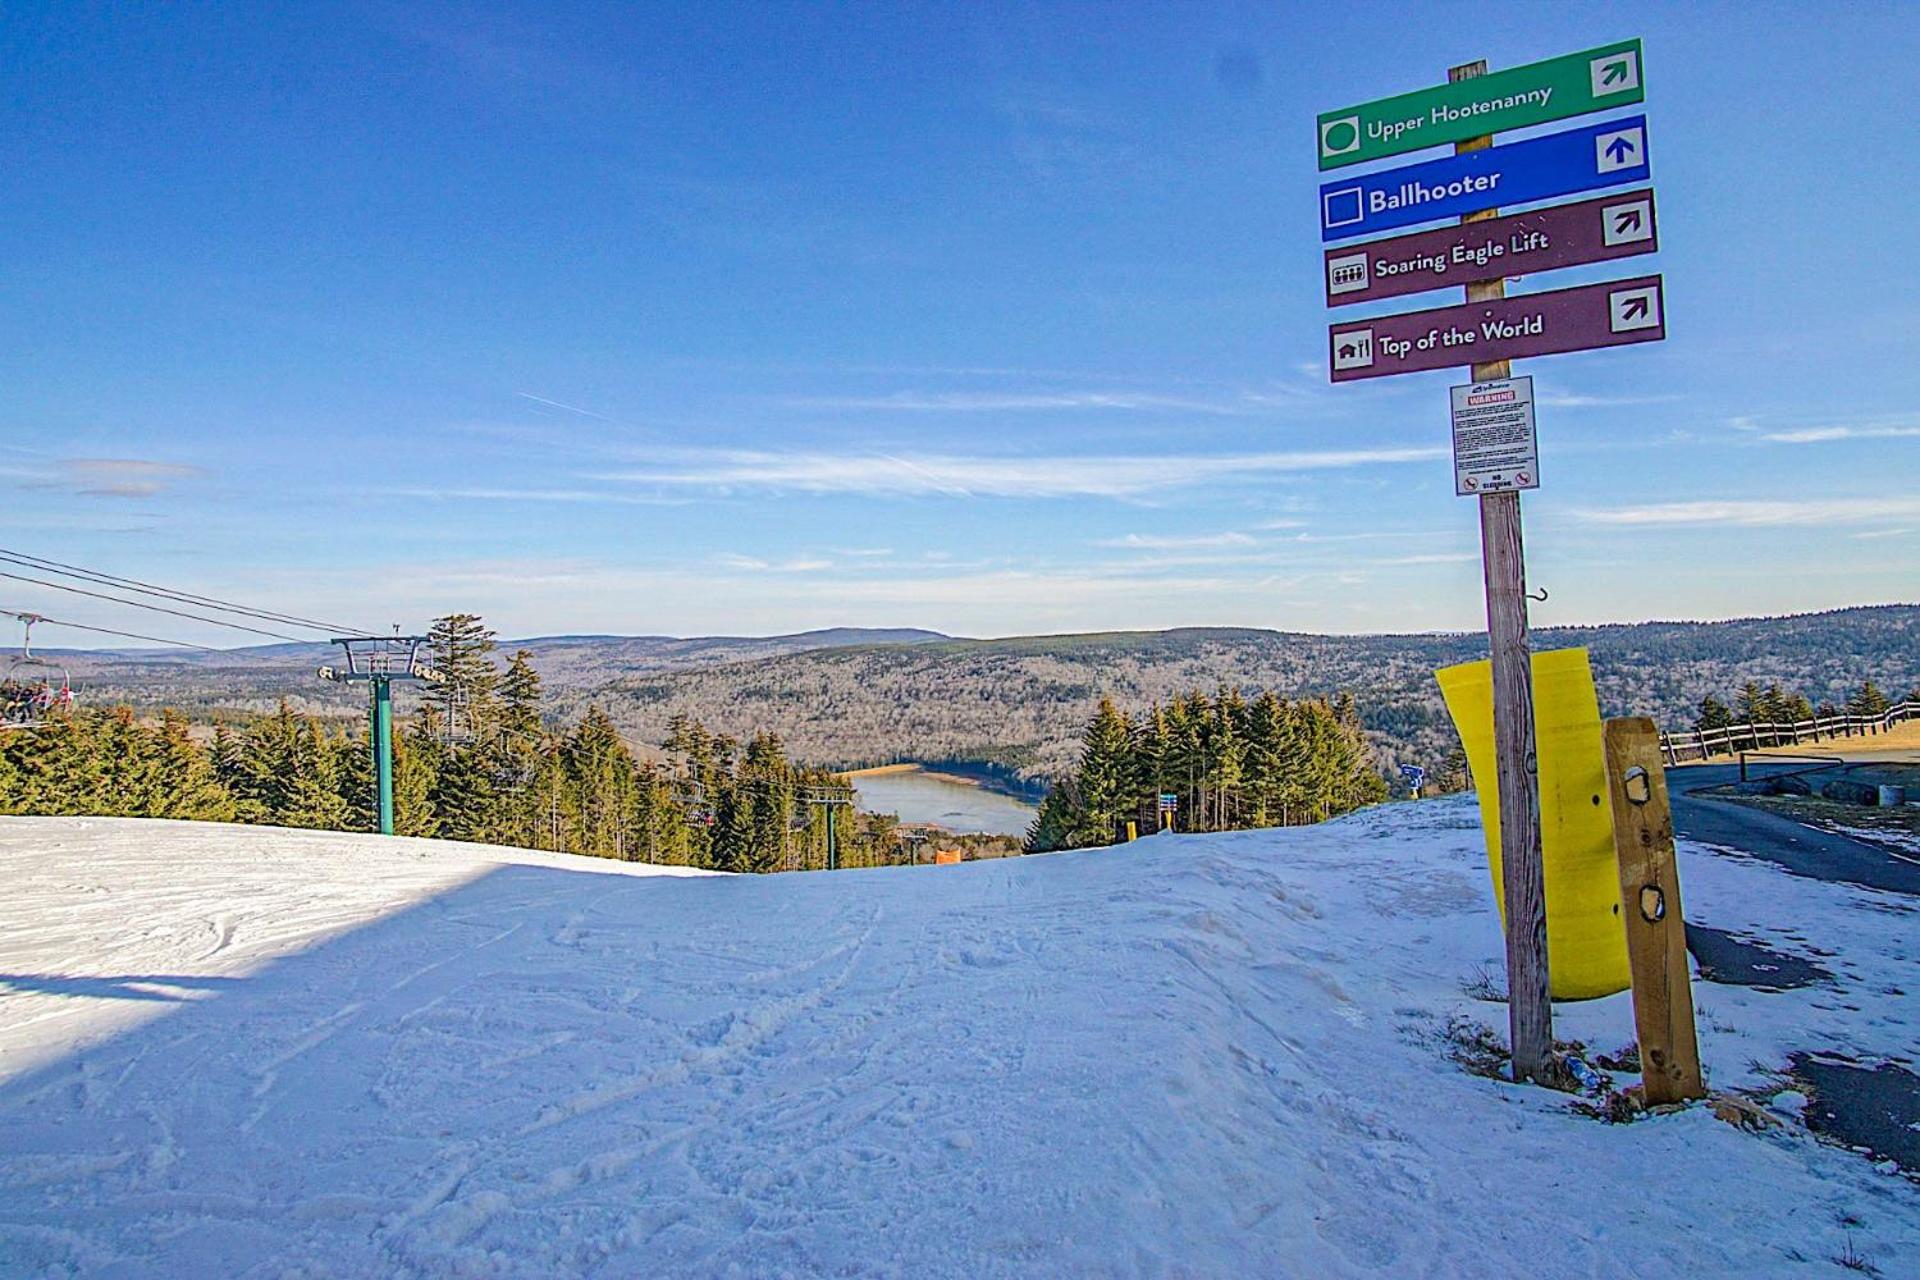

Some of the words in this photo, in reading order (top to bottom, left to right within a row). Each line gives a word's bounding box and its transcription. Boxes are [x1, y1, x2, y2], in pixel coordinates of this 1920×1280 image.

[1367, 116, 1425, 142] Upper
[1431, 87, 1552, 124] Hootenanny
[1369, 173, 1500, 213] Ballhooter
[1375, 253, 1447, 277] Soaring
[1452, 240, 1504, 265] Eagle
[1511, 232, 1549, 253] Lift
[1379, 336, 1412, 359] Top
[1416, 330, 1438, 350] of
[1442, 328, 1476, 346] the
[1481, 315, 1543, 340] World
[1469, 391, 1514, 405] WARNING
